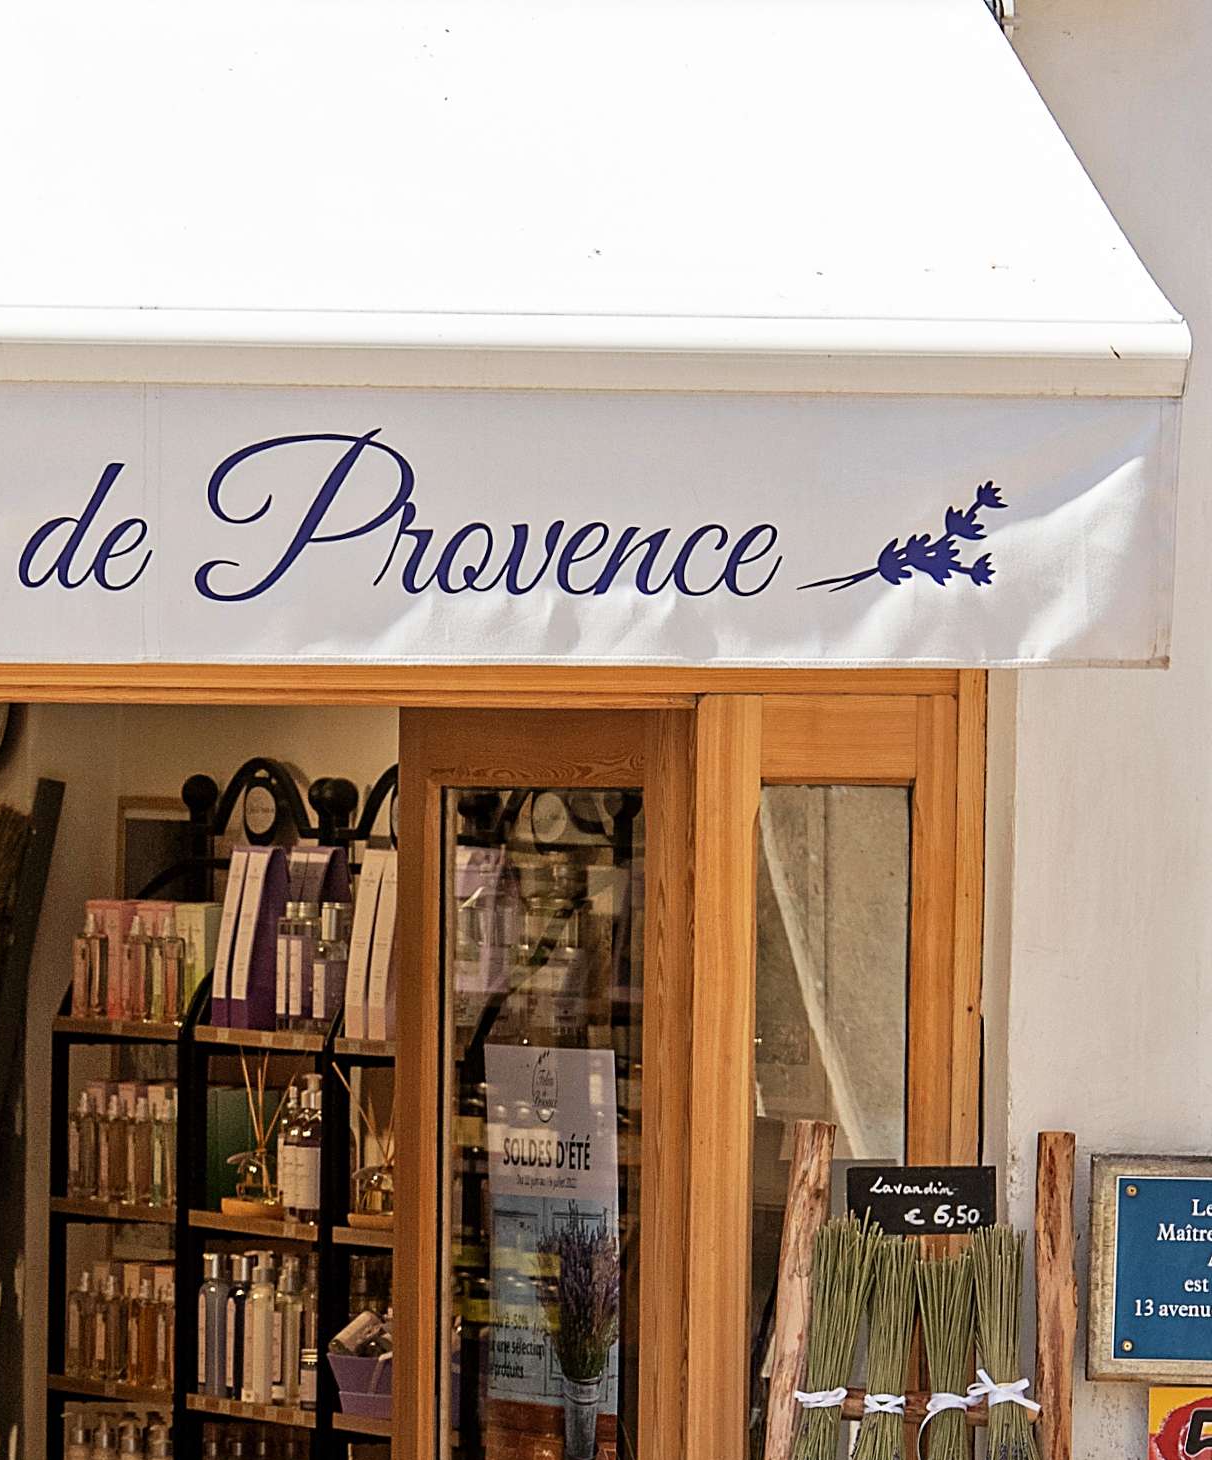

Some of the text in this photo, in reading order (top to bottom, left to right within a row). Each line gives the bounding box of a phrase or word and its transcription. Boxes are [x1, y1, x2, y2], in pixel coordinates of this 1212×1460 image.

[18, 462, 152, 591] de
[194, 427, 783, 602] Provence
[503, 1133, 591, 1171] SOLDES D'ÉTÉ
[869, 1176, 956, 1196] Lavandin
[903, 1204, 981, 1228] € 6,50
[1184, 1278, 1209, 1293] est
[1134, 1298, 1212, 1317] 13 avenu
